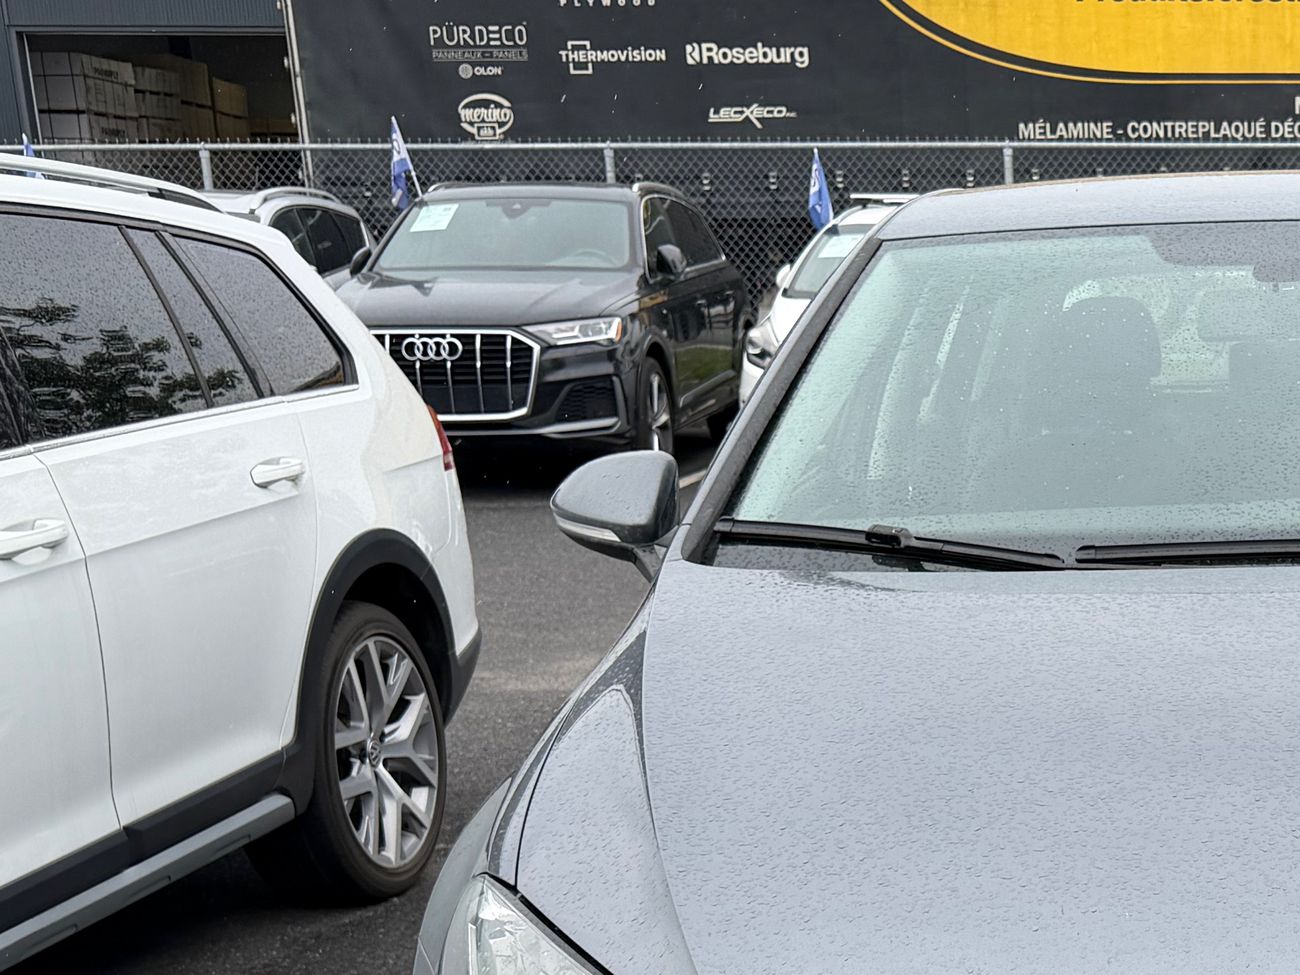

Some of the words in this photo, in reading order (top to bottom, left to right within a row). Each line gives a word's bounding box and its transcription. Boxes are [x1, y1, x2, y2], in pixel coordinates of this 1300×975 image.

[700, 41, 810, 68] Roseburg
[474, 66, 503, 76] OLON
[460, 104, 511, 123] merino
[1018, 119, 1114, 140] MÉLAMINE
[1126, 118, 1267, 140] CONTREPLAQUÉ
